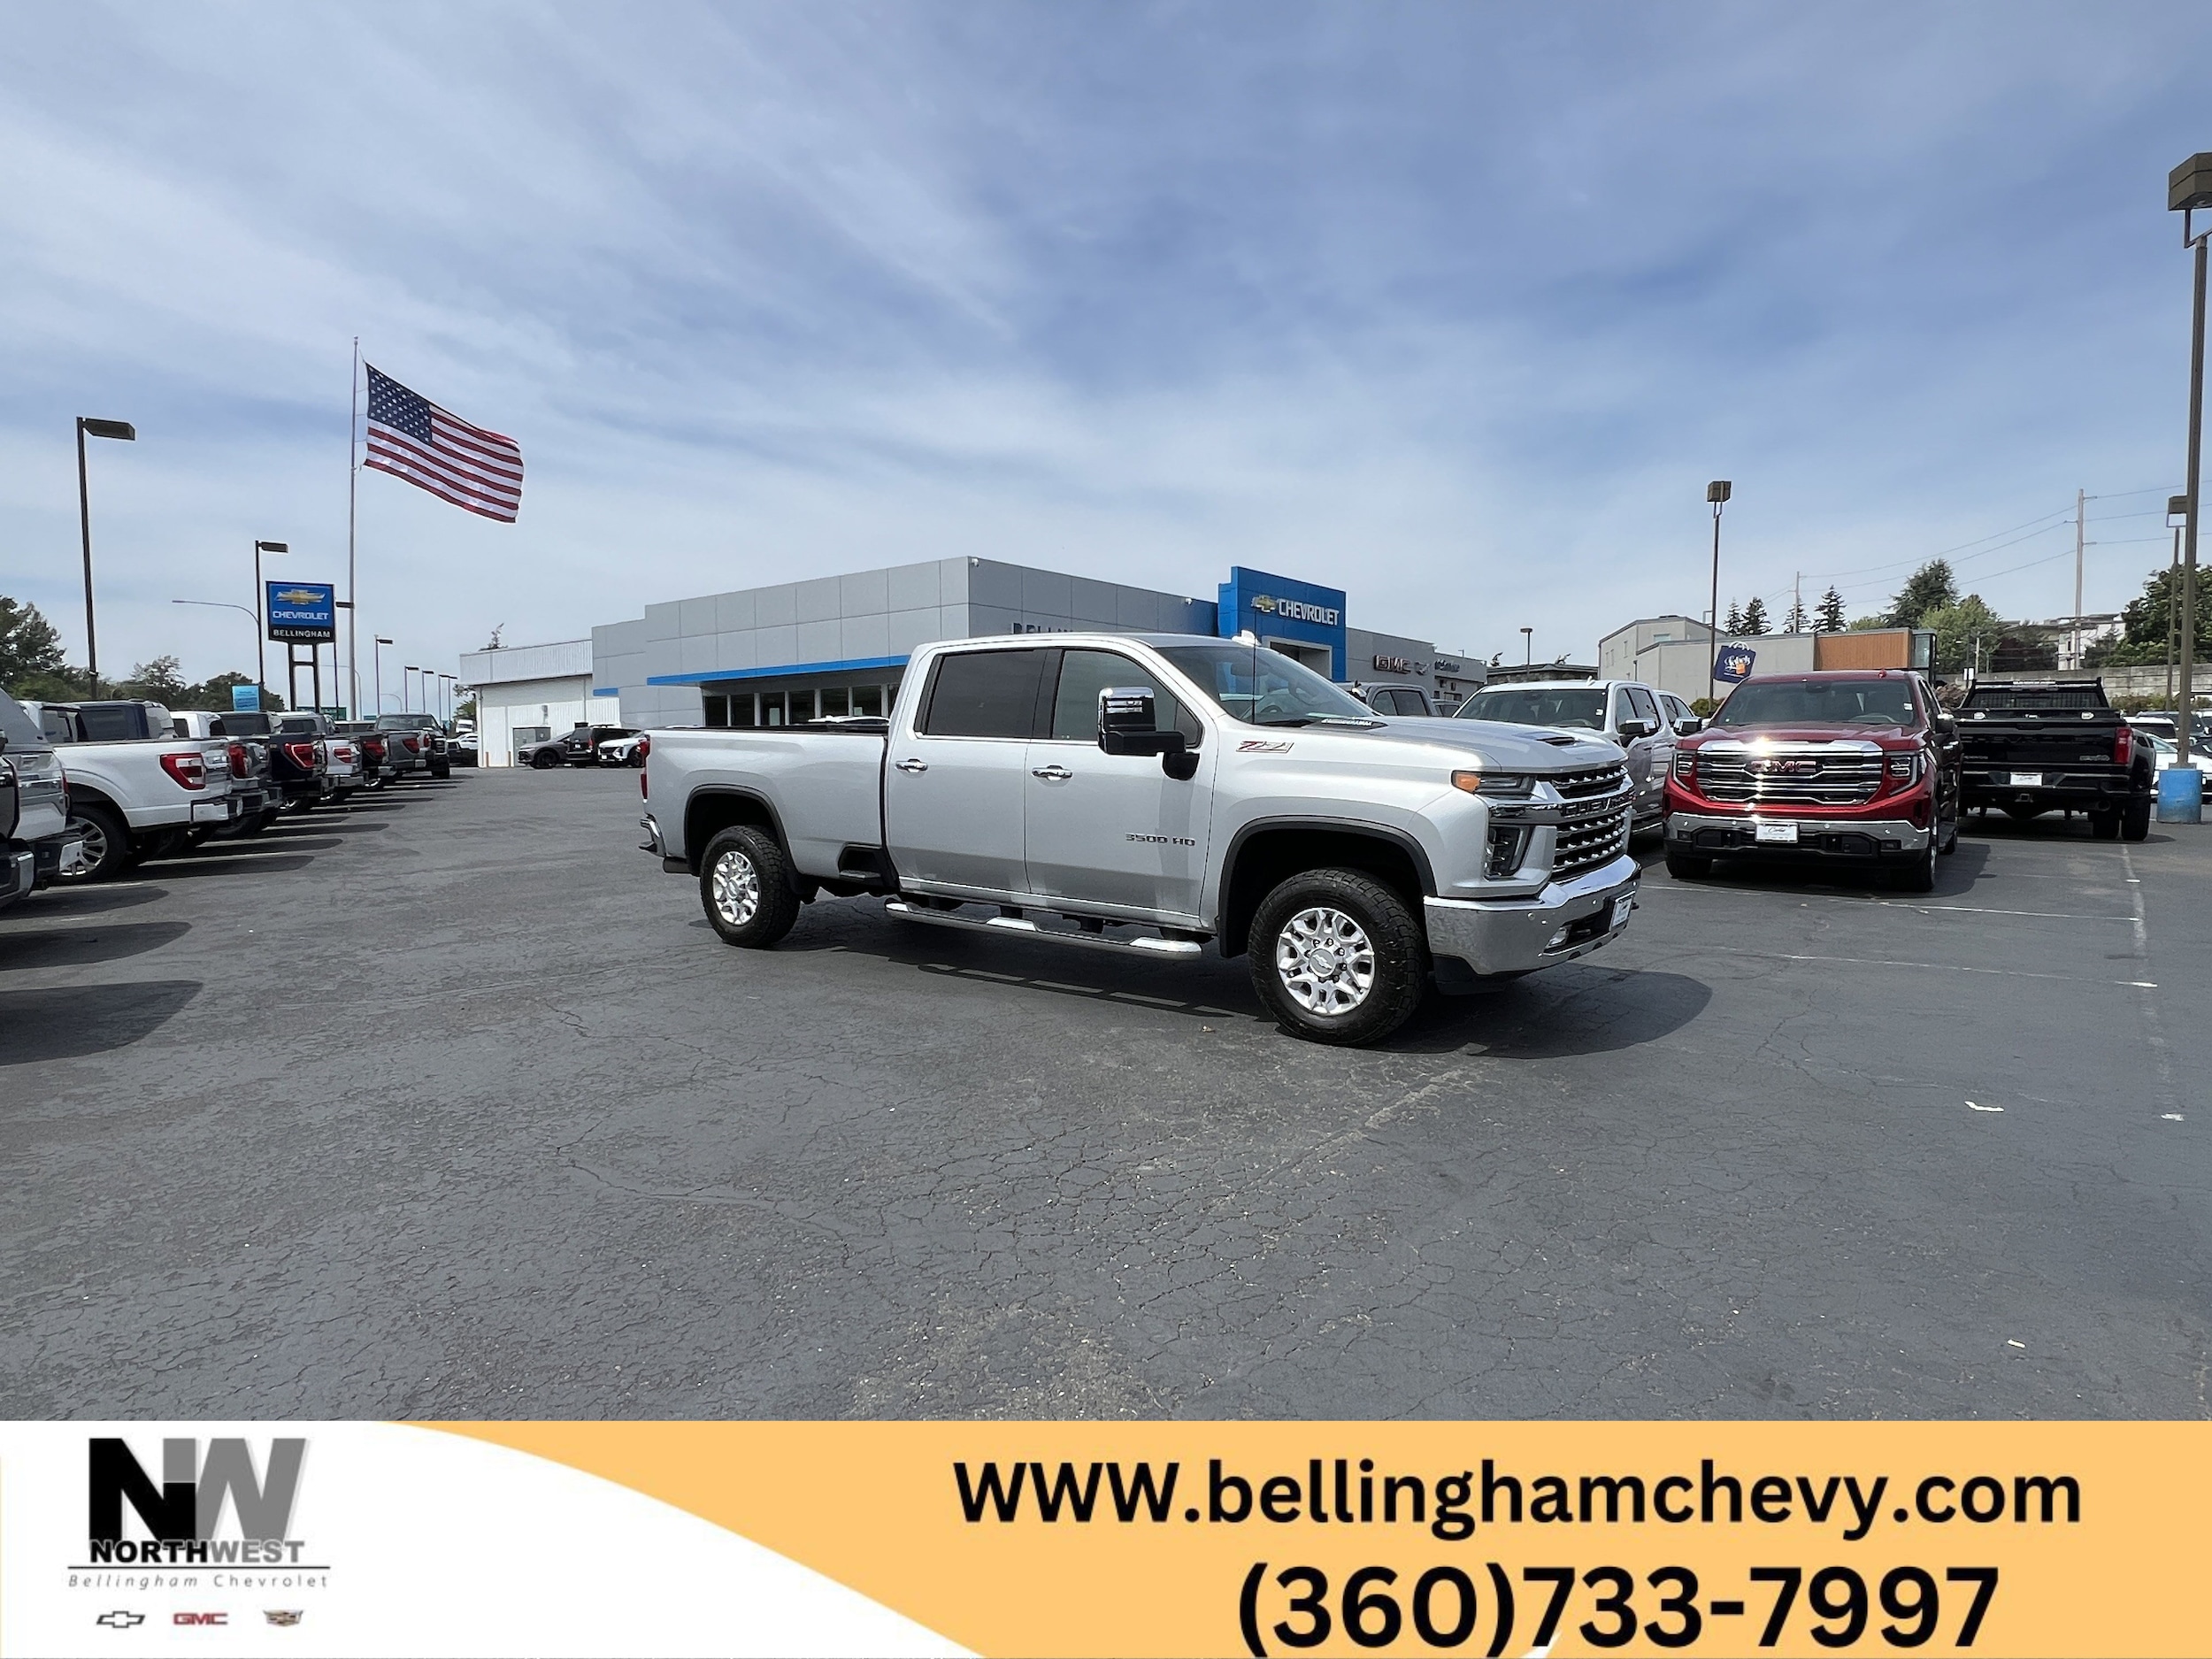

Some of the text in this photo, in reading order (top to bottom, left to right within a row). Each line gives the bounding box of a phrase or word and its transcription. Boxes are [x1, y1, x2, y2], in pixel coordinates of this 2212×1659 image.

[273, 611, 328, 619] CHEVROLET
[1277, 599, 1339, 626] CHEVROLET
[1374, 655, 1411, 673] GMC
[1751, 761, 1816, 772] GMC
[1125, 833, 1195, 847] 3500 HD
